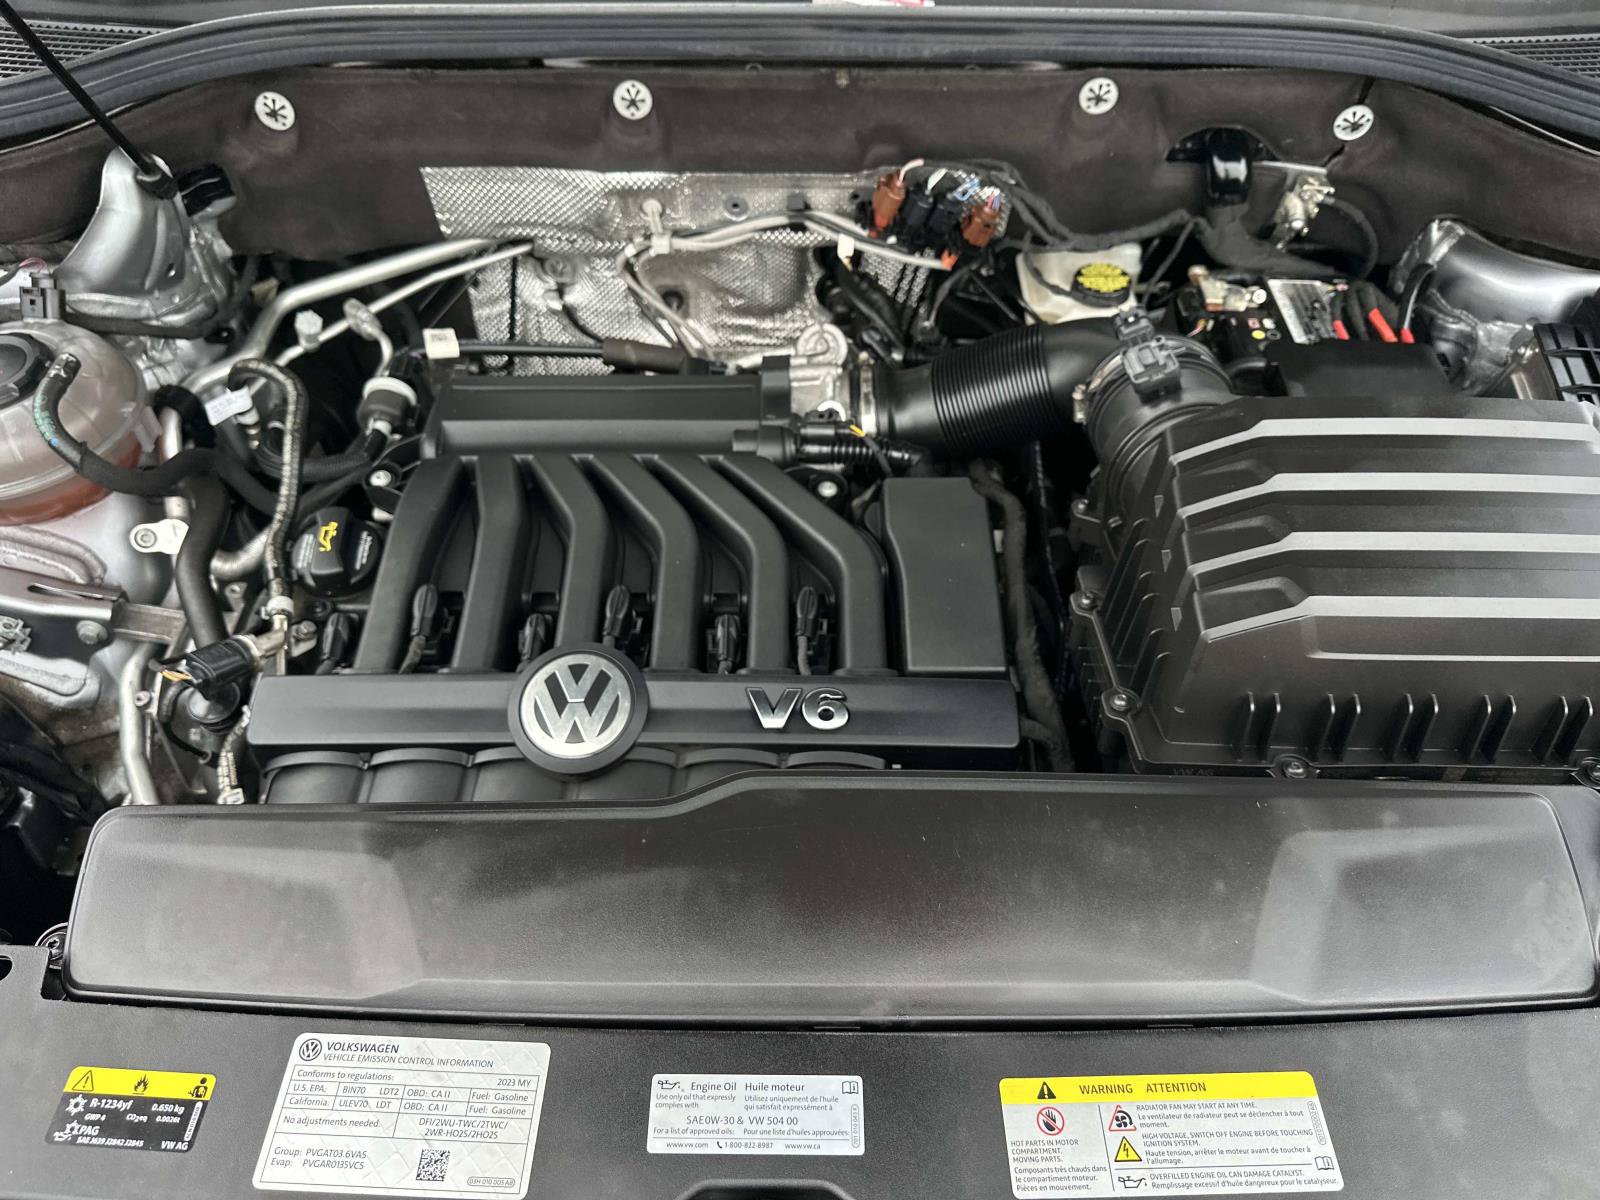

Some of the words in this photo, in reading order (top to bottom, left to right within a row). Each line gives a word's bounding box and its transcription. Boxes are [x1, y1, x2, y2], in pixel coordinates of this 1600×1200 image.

[745, 686, 850, 730] V6
[327, 1041, 399, 1054] VOLKSWAGEN
[324, 1053, 356, 1061] VEHICLE
[358, 1055, 396, 1064] EMISSION
[398, 1056, 434, 1066] CONTROL
[437, 1058, 494, 1068] INFORMATION
[298, 1069, 335, 1078] Conforms
[348, 1071, 394, 1081] regulations:
[294, 1084, 308, 1092] U.S.
[310, 1084, 326, 1092] EPA:
[342, 1086, 366, 1094] BIN70
[691, 1082, 721, 1093] Engine
[724, 1082, 736, 1091] Oil
[745, 1082, 769, 1091] Huile
[771, 1083, 805, 1091] moteur
[1079, 1084, 1133, 1094] WARNING
[1146, 1082, 1206, 1093] ATTENTION
[407, 1089, 427, 1097] OBD:
[432, 1090, 442, 1098] CA
[472, 1092, 490, 1100] Fuel:
[494, 1092, 528, 1101] Gasoline
[707, 1094, 736, 1102] expressly
[90, 1098, 133, 1111] R-1234yf
[152, 1103, 174, 1112] 0.650
[174, 1104, 185, 1114] kg
[290, 1097, 329, 1106] California:
[339, 1099, 368, 1107] ULEV70
[656, 1101, 683, 1110] complies
[428, 1103, 439, 1111] CA
[469, 1105, 488, 1114] Fuel:
[492, 1106, 526, 1115] Gasoline
[782, 1104, 827, 1112] expressément
[297, 1117, 347, 1126] adjustments
[349, 1119, 381, 1127] needed.
[419, 1118, 508, 1129] DFI/2WU-TWC/2TWC/
[686, 1116, 734, 1124] SAE0W-30
[737, 1116, 744, 1125] &
[748, 1116, 764, 1125] VW
[768, 1117, 784, 1125] 504
[787, 1117, 798, 1125] 00
[79, 1125, 100, 1136] PAG
[425, 1128, 498, 1139] 2WR-HO2S/2HO2S
[690, 1127, 719, 1136] approved
[161, 1140, 176, 1149] VW
[175, 1141, 189, 1150] AG
[274, 1146, 302, 1157] Group:
[271, 1158, 292, 1168] Evap:
[1014, 1166, 1053, 1175] Composants
[1024, 1175, 1070, 1184] compartiment
